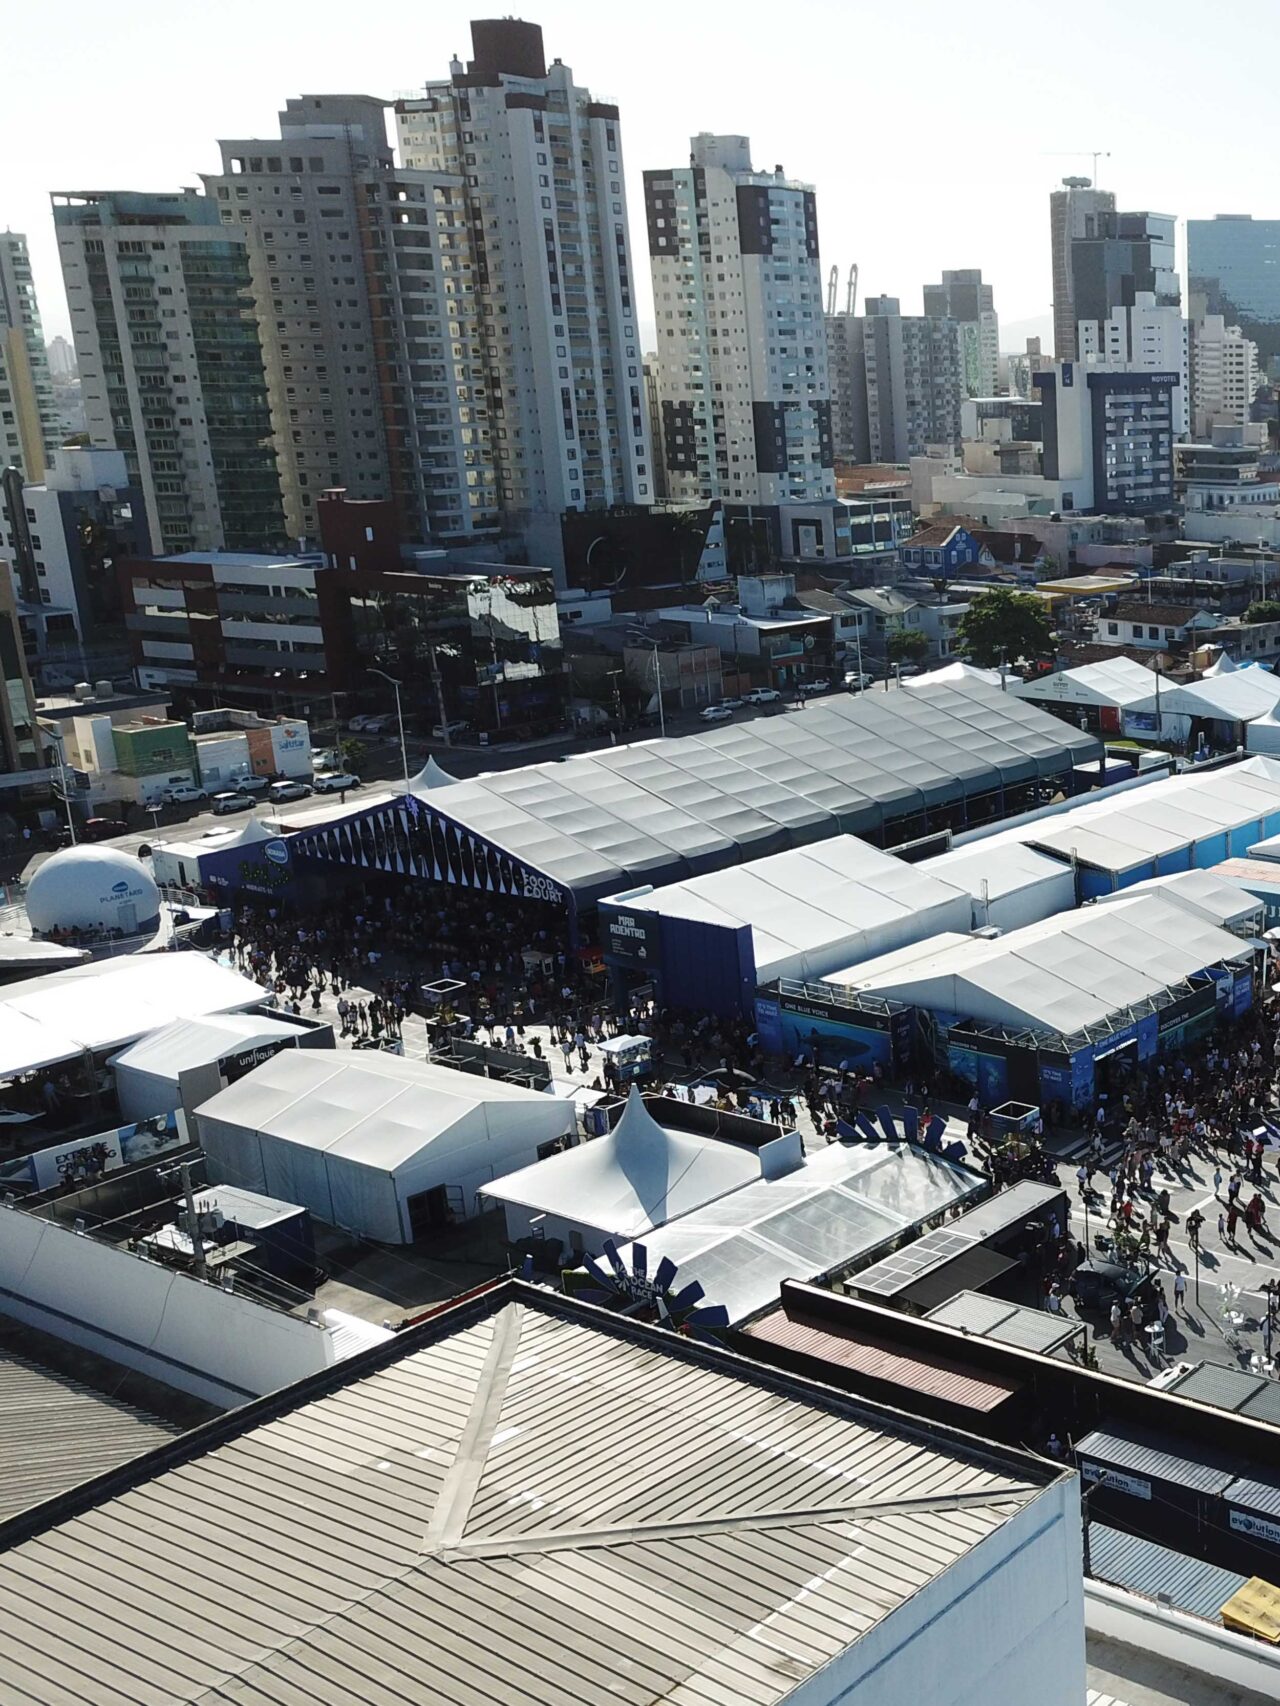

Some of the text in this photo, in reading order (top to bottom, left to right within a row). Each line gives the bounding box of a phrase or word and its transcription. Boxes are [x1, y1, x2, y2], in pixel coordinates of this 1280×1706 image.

[1151, 375, 1177, 383] NOVOTEL
[523, 873, 554, 891] FOOD
[524, 885, 563, 903] COURT
[610, 923, 646, 940] ADENTRO
[784, 1002, 829, 1018] ONE BLUE VOICE
[239, 1048, 275, 1067] unifique
[631, 1276, 663, 1293] OCEAN
[631, 1286, 653, 1299] RACE
